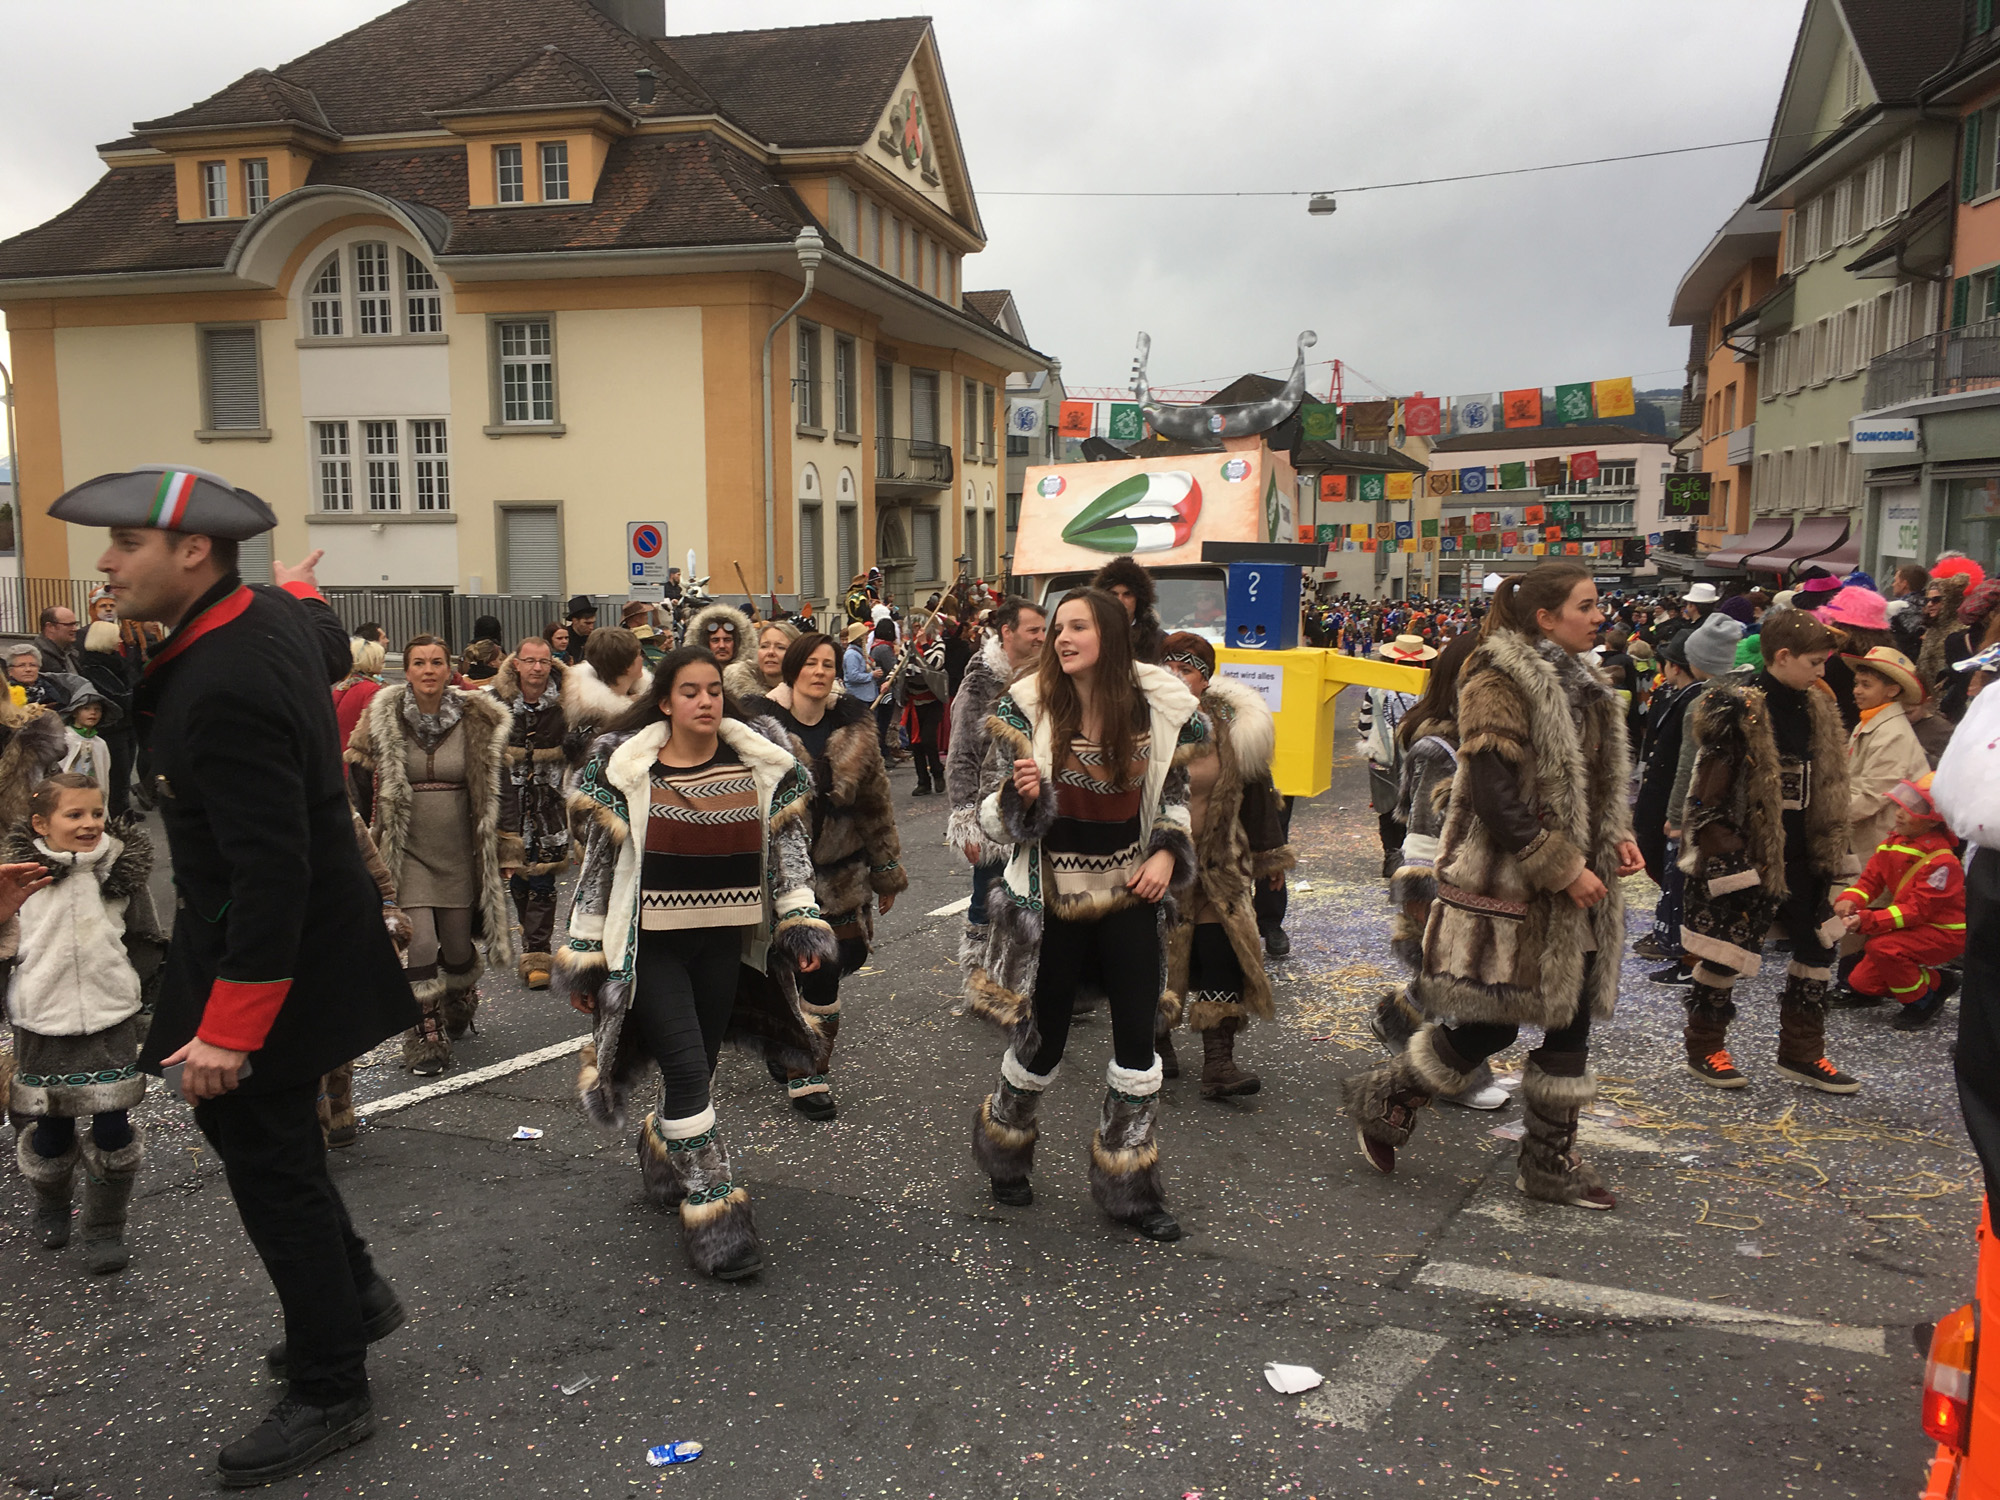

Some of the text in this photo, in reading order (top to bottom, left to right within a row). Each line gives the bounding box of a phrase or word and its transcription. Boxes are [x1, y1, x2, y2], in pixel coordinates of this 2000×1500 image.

[1856, 428, 1915, 442] CONCORDIA
[1666, 477, 1701, 492] Café
[1672, 491, 1710, 514] Bijou
[1240, 671, 1256, 679] wird
[1257, 672, 1275, 681] alles
